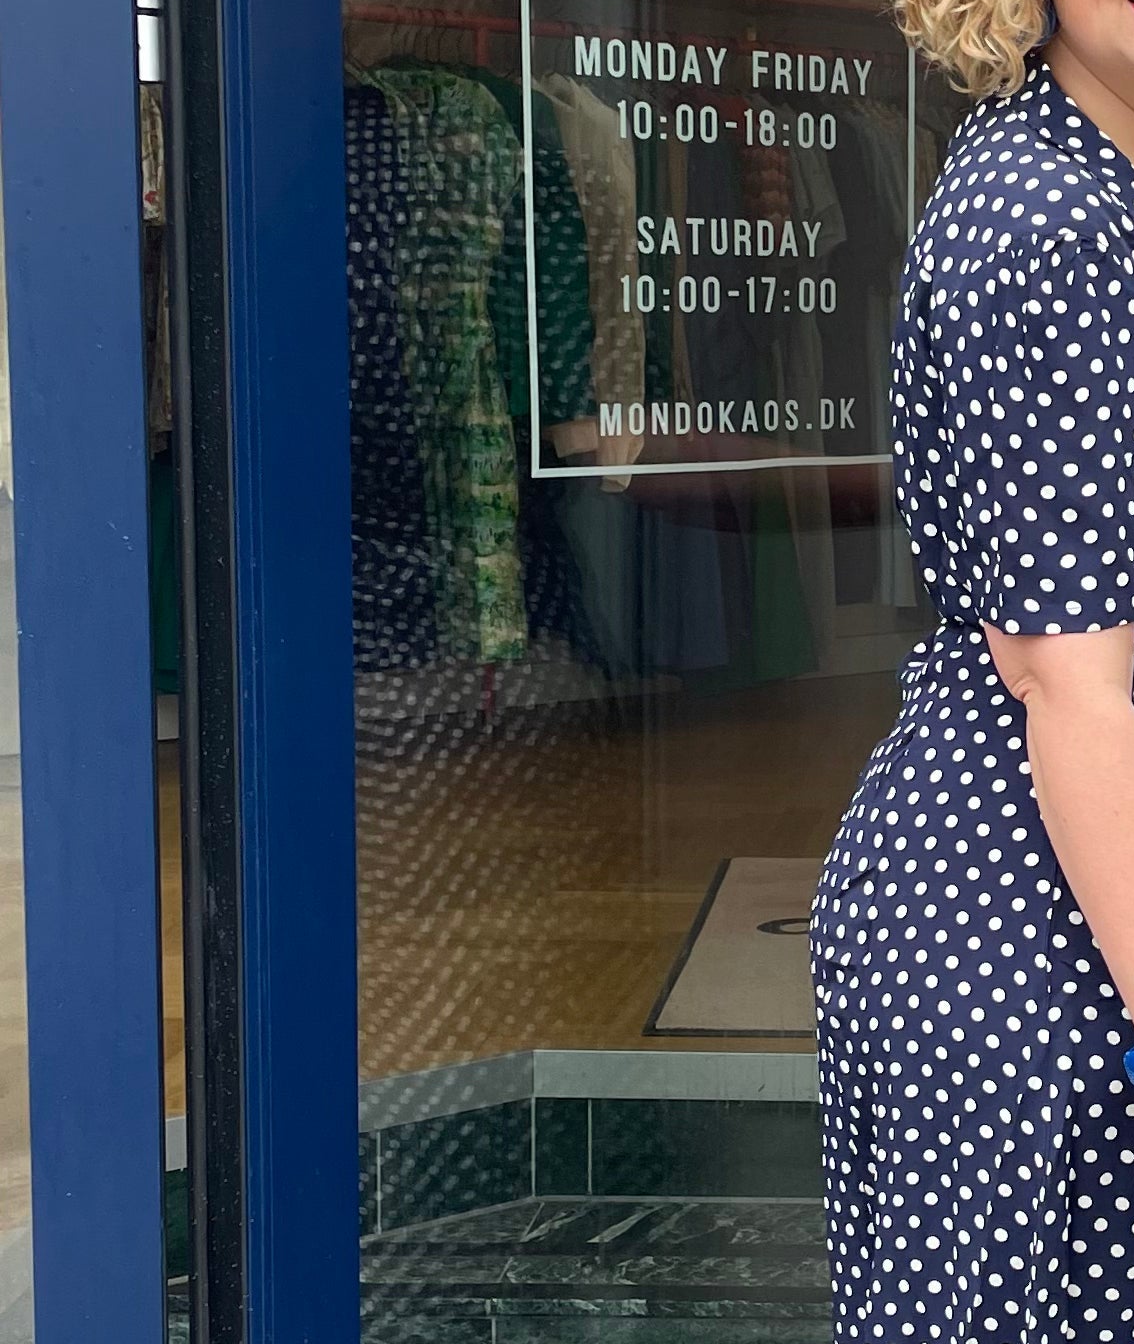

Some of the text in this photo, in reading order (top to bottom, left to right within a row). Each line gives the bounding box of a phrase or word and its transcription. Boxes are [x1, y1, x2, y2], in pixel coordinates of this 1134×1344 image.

[574, 35, 872, 96] MONDAY FRIDAY
[616, 99, 837, 150] 10:00-18:00
[637, 215, 822, 258] SATURDAY
[619, 273, 837, 314] 10:00-17:00
[599, 398, 856, 437] MONDOKAOS.DK
